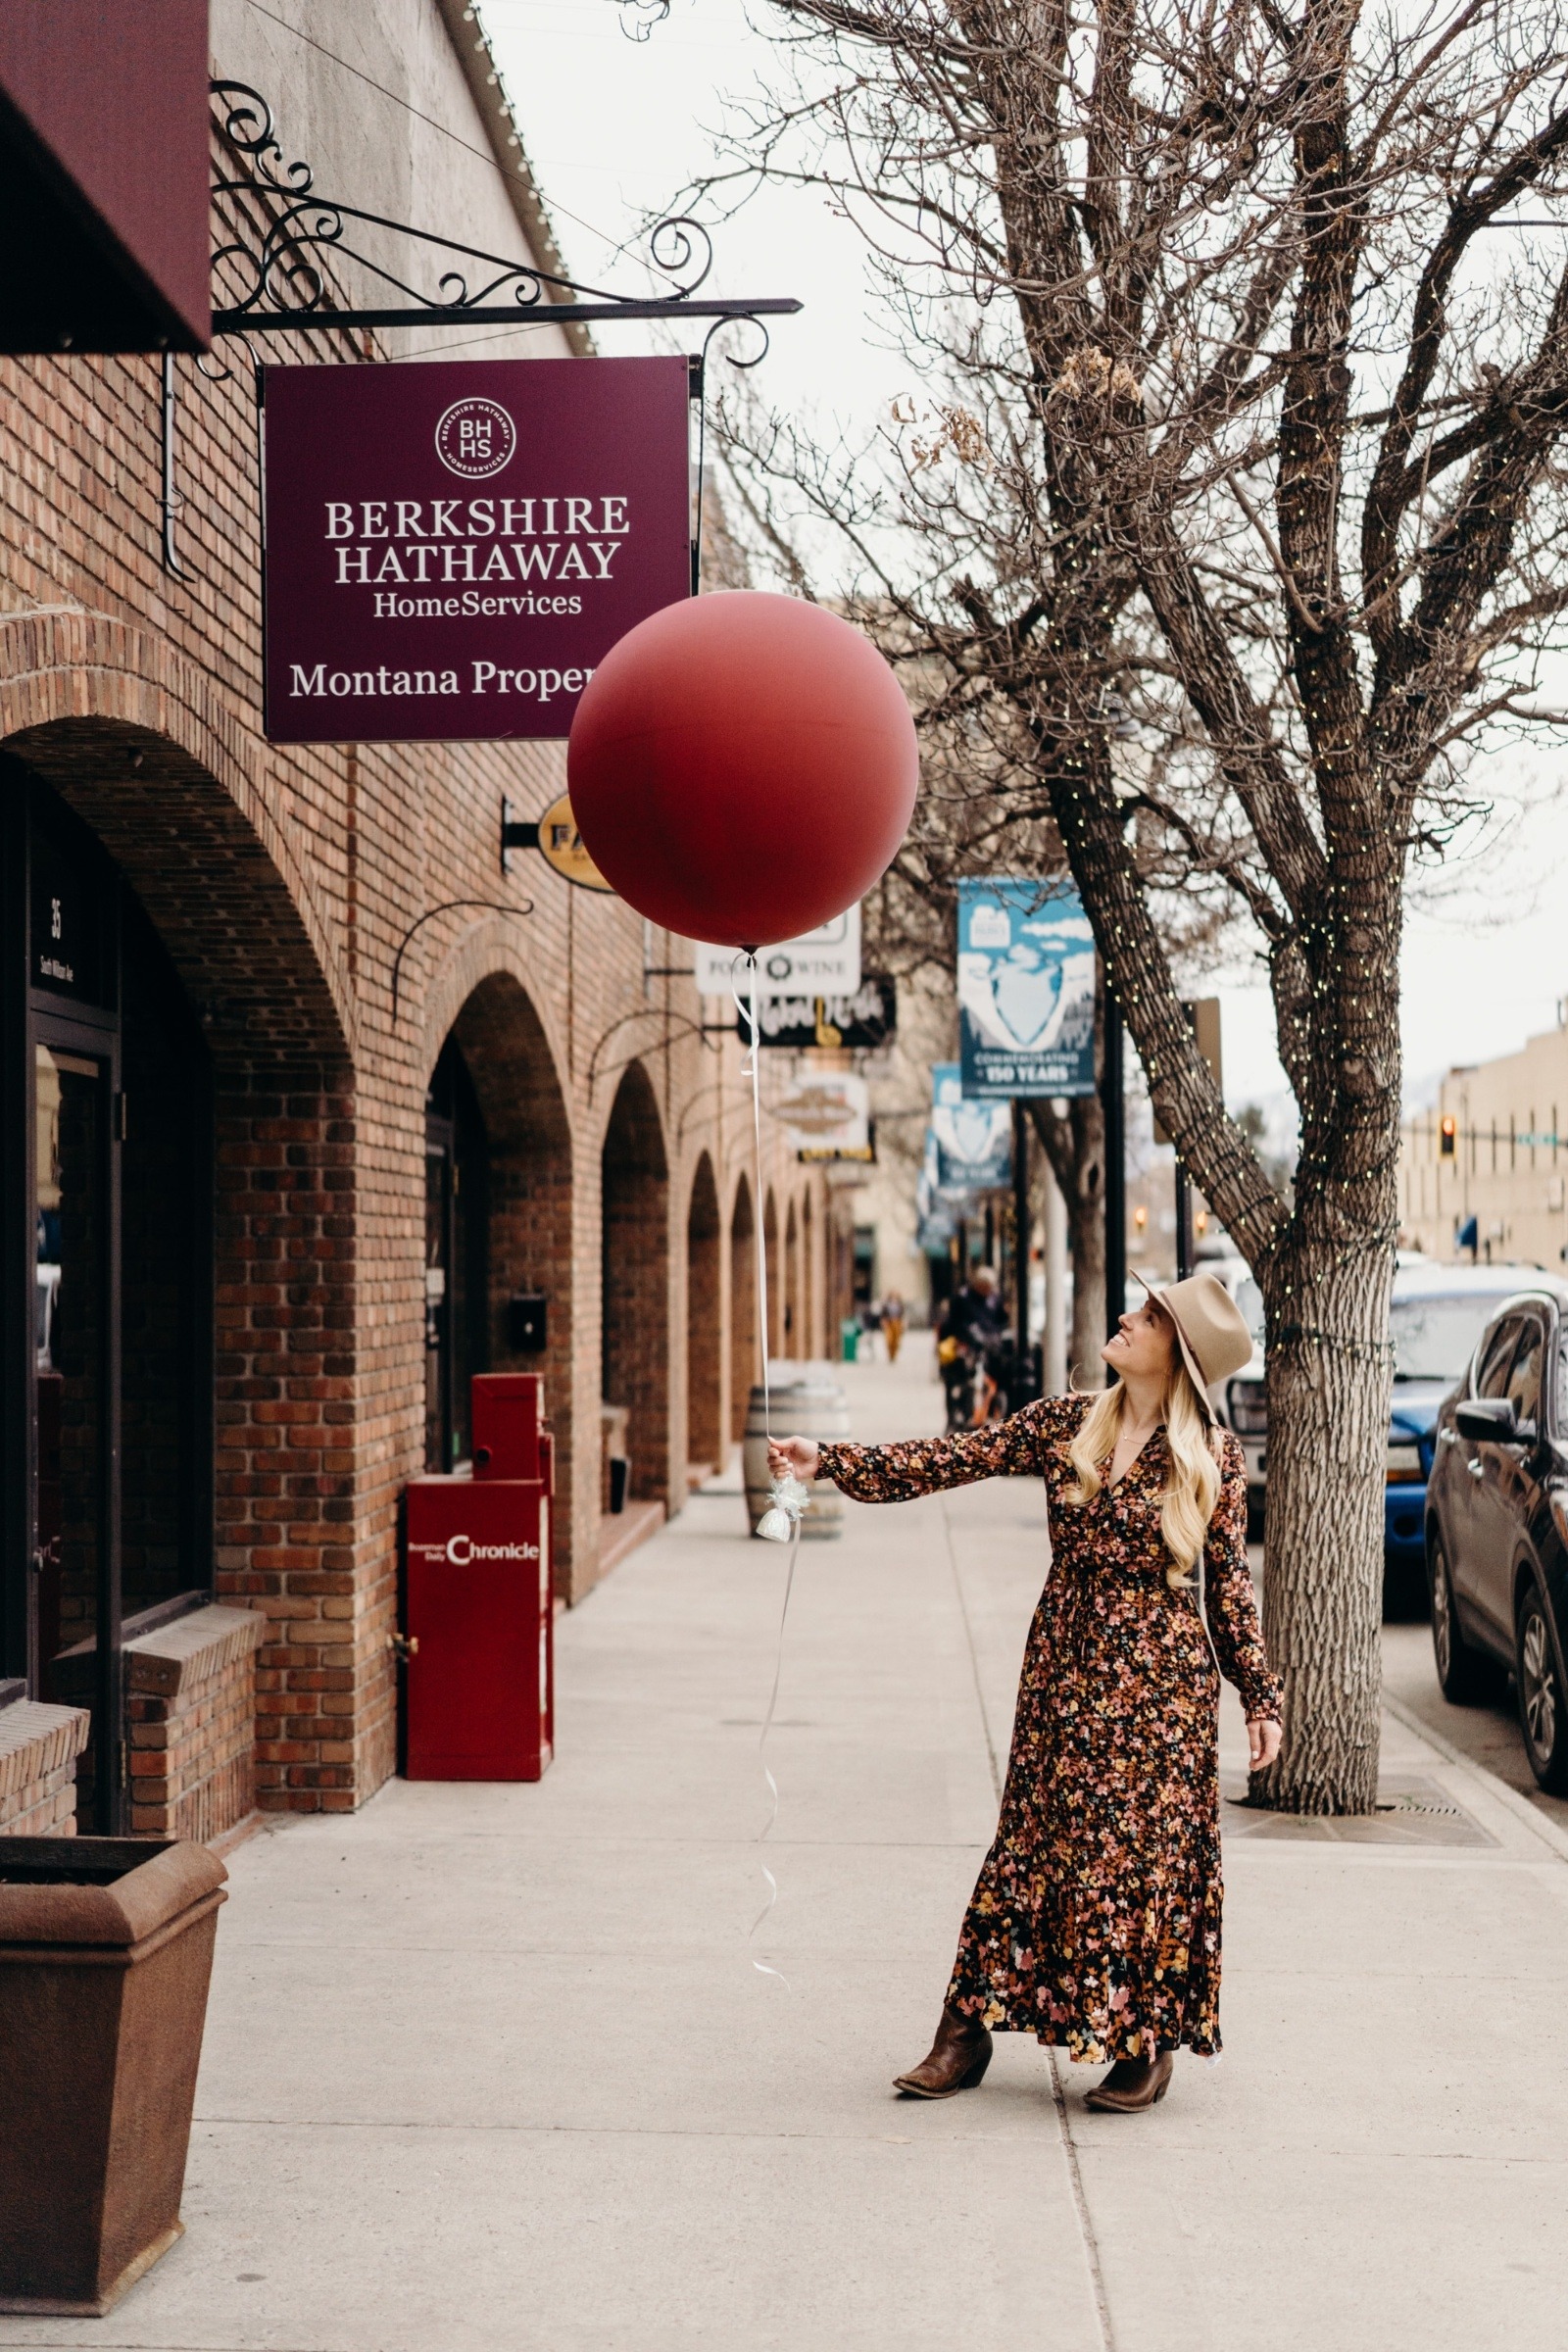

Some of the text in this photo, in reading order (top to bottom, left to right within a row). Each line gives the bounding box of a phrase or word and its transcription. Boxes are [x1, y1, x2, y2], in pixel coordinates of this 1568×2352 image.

[441, 404, 511, 441] BERKSHIRE HATHAWAY
[460, 418, 492, 438] BH
[446, 452, 506, 473] HOMESERVICES
[460, 438, 492, 459] HS
[324, 496, 630, 539] BERKSHIRE
[334, 542, 622, 584] HATHAWAY
[373, 589, 582, 617] HomeServices
[289, 663, 461, 697] Montana
[797, 958, 846, 976] WINE
[1016, 1065, 1069, 1082] YEARS
[446, 1534, 539, 1566] Chronicle
